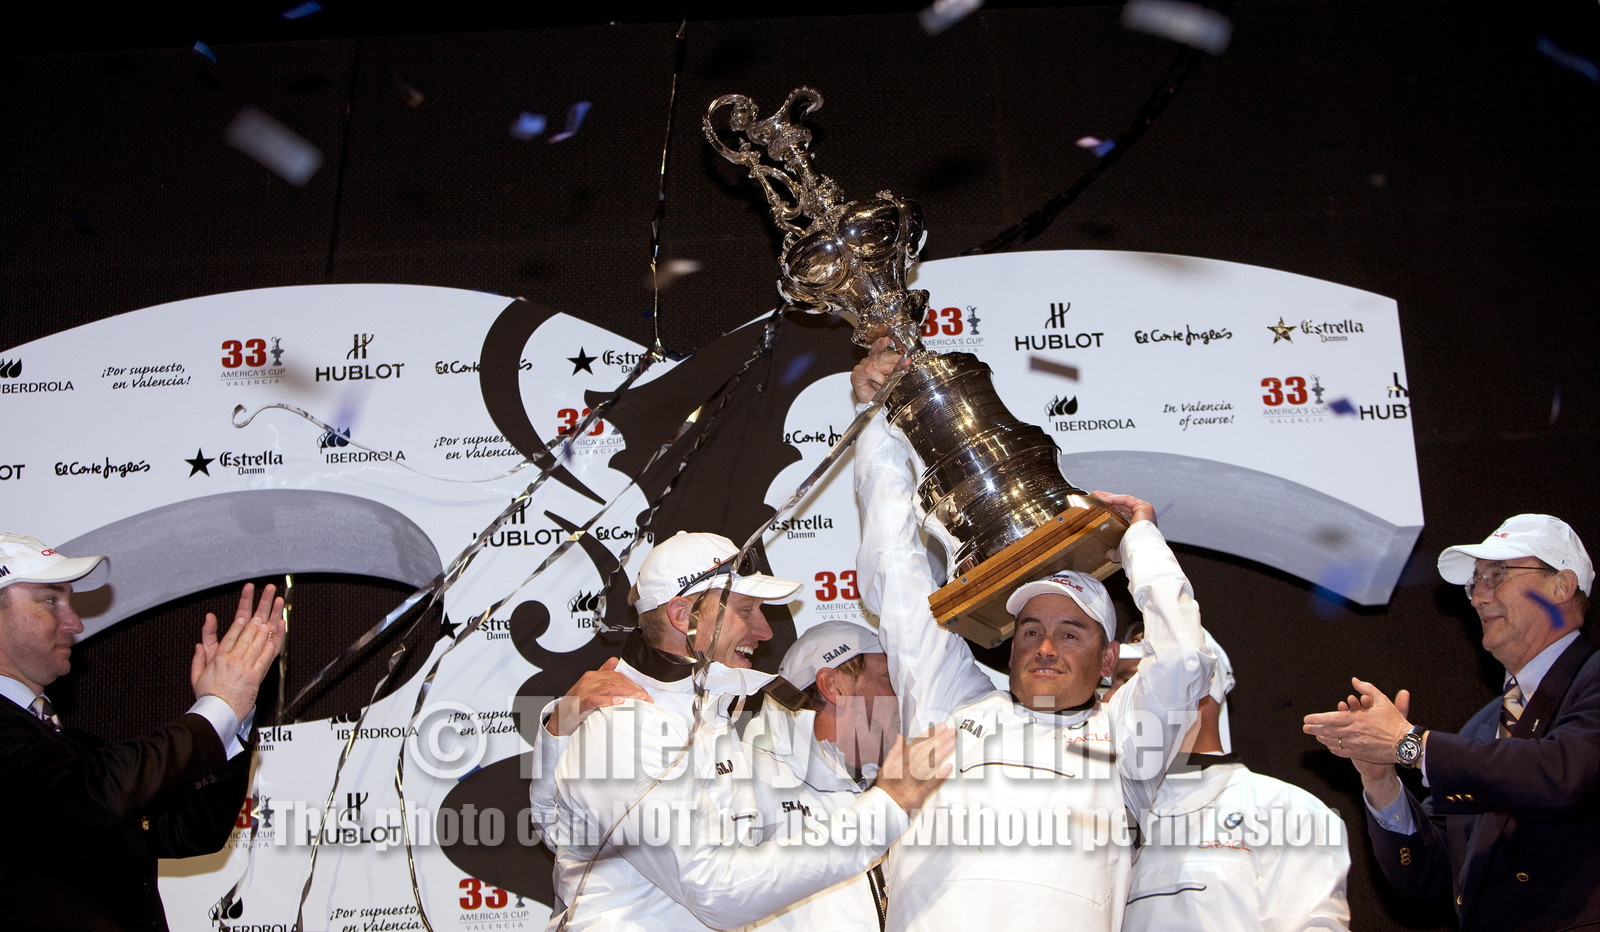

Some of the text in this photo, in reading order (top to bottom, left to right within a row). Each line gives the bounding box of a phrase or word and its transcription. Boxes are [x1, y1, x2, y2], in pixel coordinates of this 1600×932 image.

[1301, 320, 1364, 334] Estrella
[966, 337, 983, 345] CUP
[1015, 332, 1104, 351] HUBLOT
[1135, 330, 1149, 344] El
[1151, 329, 1184, 342] Corte
[221, 338, 267, 369] 33
[129, 363, 185, 380] supuesto,
[220, 368, 286, 379] AMERICA'S CUP
[315, 363, 405, 382] HUBLOT
[113, 375, 191, 390] en Valencia!
[226, 379, 280, 387] VALENCIA
[1260, 376, 1308, 406] 33
[1163, 401, 1233, 413] In Valencia
[1055, 418, 1136, 432] IBERDROLA
[1179, 414, 1234, 431] of course!
[792, 430, 826, 444] Corte
[219, 451, 283, 469] Estrella
[326, 450, 406, 464] IBERDROLA
[445, 452, 461, 460] en
[55, 462, 69, 476] El
[69, 462, 101, 476] Corte
[237, 467, 265, 476] Damm
[787, 531, 816, 540] Damm
[814, 569, 861, 602] 33
[815, 602, 863, 611] AMERICA'S
[822, 643, 851, 663] SLAM
[337, 727, 418, 741] IBRDROLA
[460, 727, 478, 736] en
[258, 831, 275, 840] CUP
[307, 826, 401, 845] HUBLOT
[459, 878, 508, 910] 33
[459, 911, 529, 921] AMERICA'S CUP
[466, 922, 523, 930] VALENCIA
